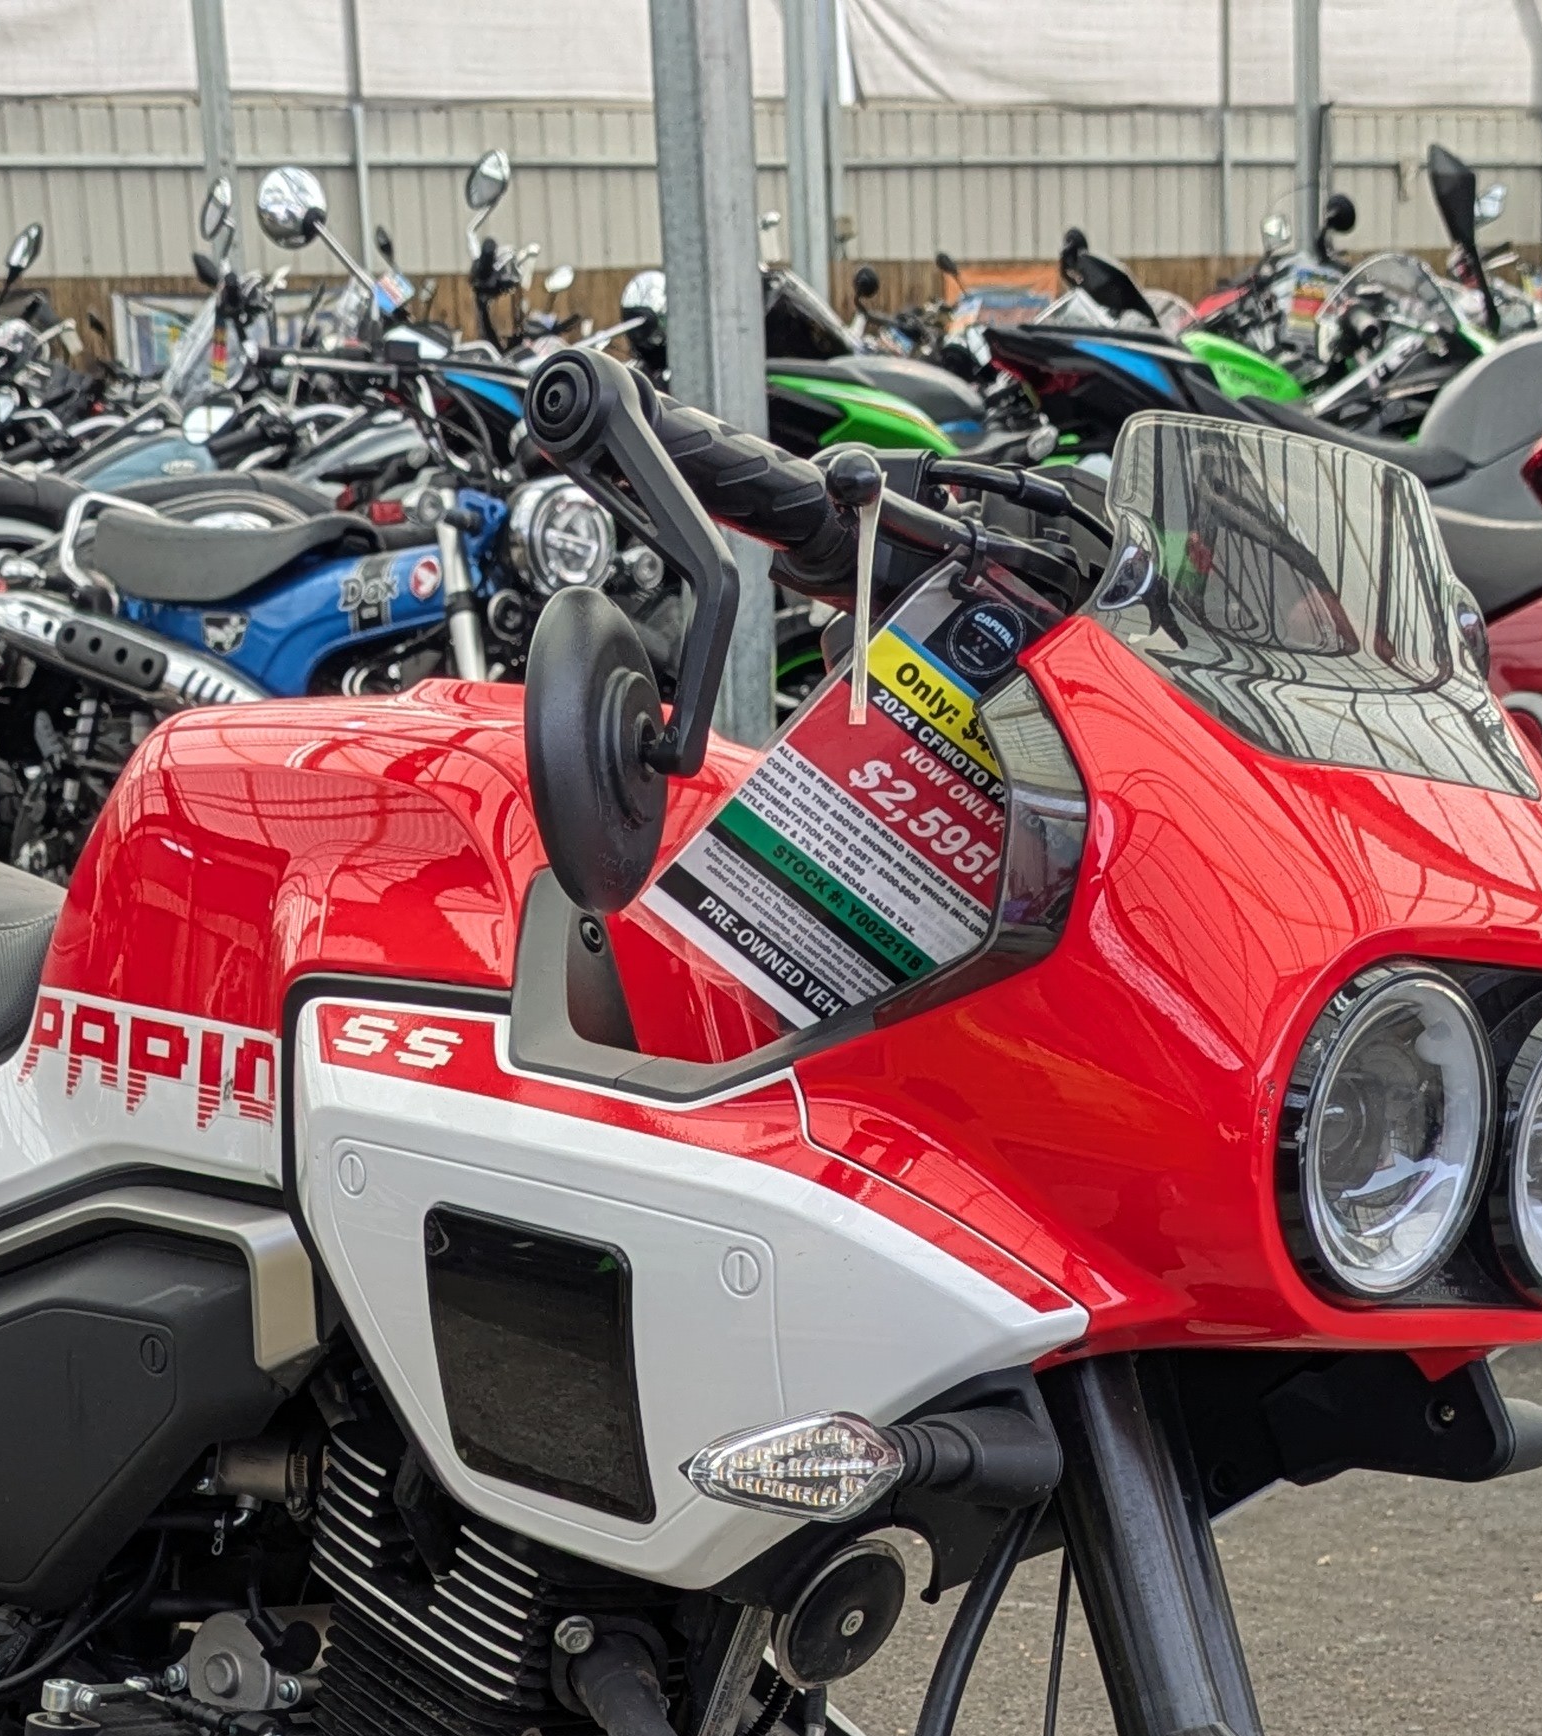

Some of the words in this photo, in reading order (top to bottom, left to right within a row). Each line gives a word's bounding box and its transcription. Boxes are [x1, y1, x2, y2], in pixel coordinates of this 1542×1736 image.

[338, 578, 399, 612] Dax
[973, 611, 1015, 649] CAPITAL
[870, 687, 921, 731] 2024
[914, 723, 992, 788] CFMOTO
[896, 662, 958, 726] Only:
[962, 722, 994, 757] $4
[848, 760, 1001, 885] $2,595!
[899, 743, 954, 790] NOW
[736, 787, 765, 812] TITLE
[763, 808, 790, 832] COST
[788, 829, 798, 839] &
[797, 836, 813, 851] 3%
[811, 848, 827, 863] NC
[825, 859, 867, 895] ON-ROAD
[865, 892, 896, 919] SALES
[894, 916, 917, 937] TAX.
[745, 777, 823, 842] DOCUMENTATION
[841, 855, 866, 877] $599
[754, 767, 792, 799] DEALER
[790, 796, 824, 825] CHECK
[820, 821, 849, 846] OVER
[847, 843, 873, 866] COST
[875, 866, 921, 905] $500-$600
[764, 756, 798, 784] COSTS
[796, 781, 812, 796] TO
[810, 793, 831, 811] THE
[828, 808, 862, 837] ABOVE
[859, 833, 895, 864] SHOWN
[892, 861, 921, 886] PRICE
[919, 883, 951, 910] WHICH
[775, 744, 796, 763] ALL
[794, 760, 817, 780] OUR
[814, 776, 866, 820] PRE-LOVED
[863, 816, 905, 853] ON-ROAD
[903, 850, 948, 887] VEHICLES
[945, 885, 971, 907] HAVE
[697, 895, 808, 987] PRE-OWNED
[803, 979, 847, 1018] VEH
[702, 846, 724, 866] Rates
[721, 863, 736, 877] can
[750, 885, 773, 906] O.A.C.
[770, 902, 789, 919] They
[786, 915, 798, 926] do
[795, 922, 809, 935] not
[806, 931, 833, 955] include
[830, 952, 844, 965] any
[842, 960, 853, 971] of
[849, 967, 863, 979] the
[705, 863, 729, 883] added
[725, 880, 746, 898] parts
[743, 895, 753, 904] or
[750, 900, 792, 936] accessories.
[790, 932, 804, 945] ALL
[802, 942, 821, 959] used
[818, 955, 847, 981] vehicles
[844, 978, 857, 989] are
[738, 862, 759, 880] based
[756, 877, 766, 886] on
[812, 923, 831, 940] price
[828, 936, 844, 950] only
[841, 946, 857, 960] with
[755, 918, 795, 952] specifically
[792, 948, 815, 968] stated
[812, 965, 847, 995] otherwise.
[770, 843, 831, 895] STOCK
[843, 903, 925, 972] Y002211B
[331, 1014, 464, 1070] SS
